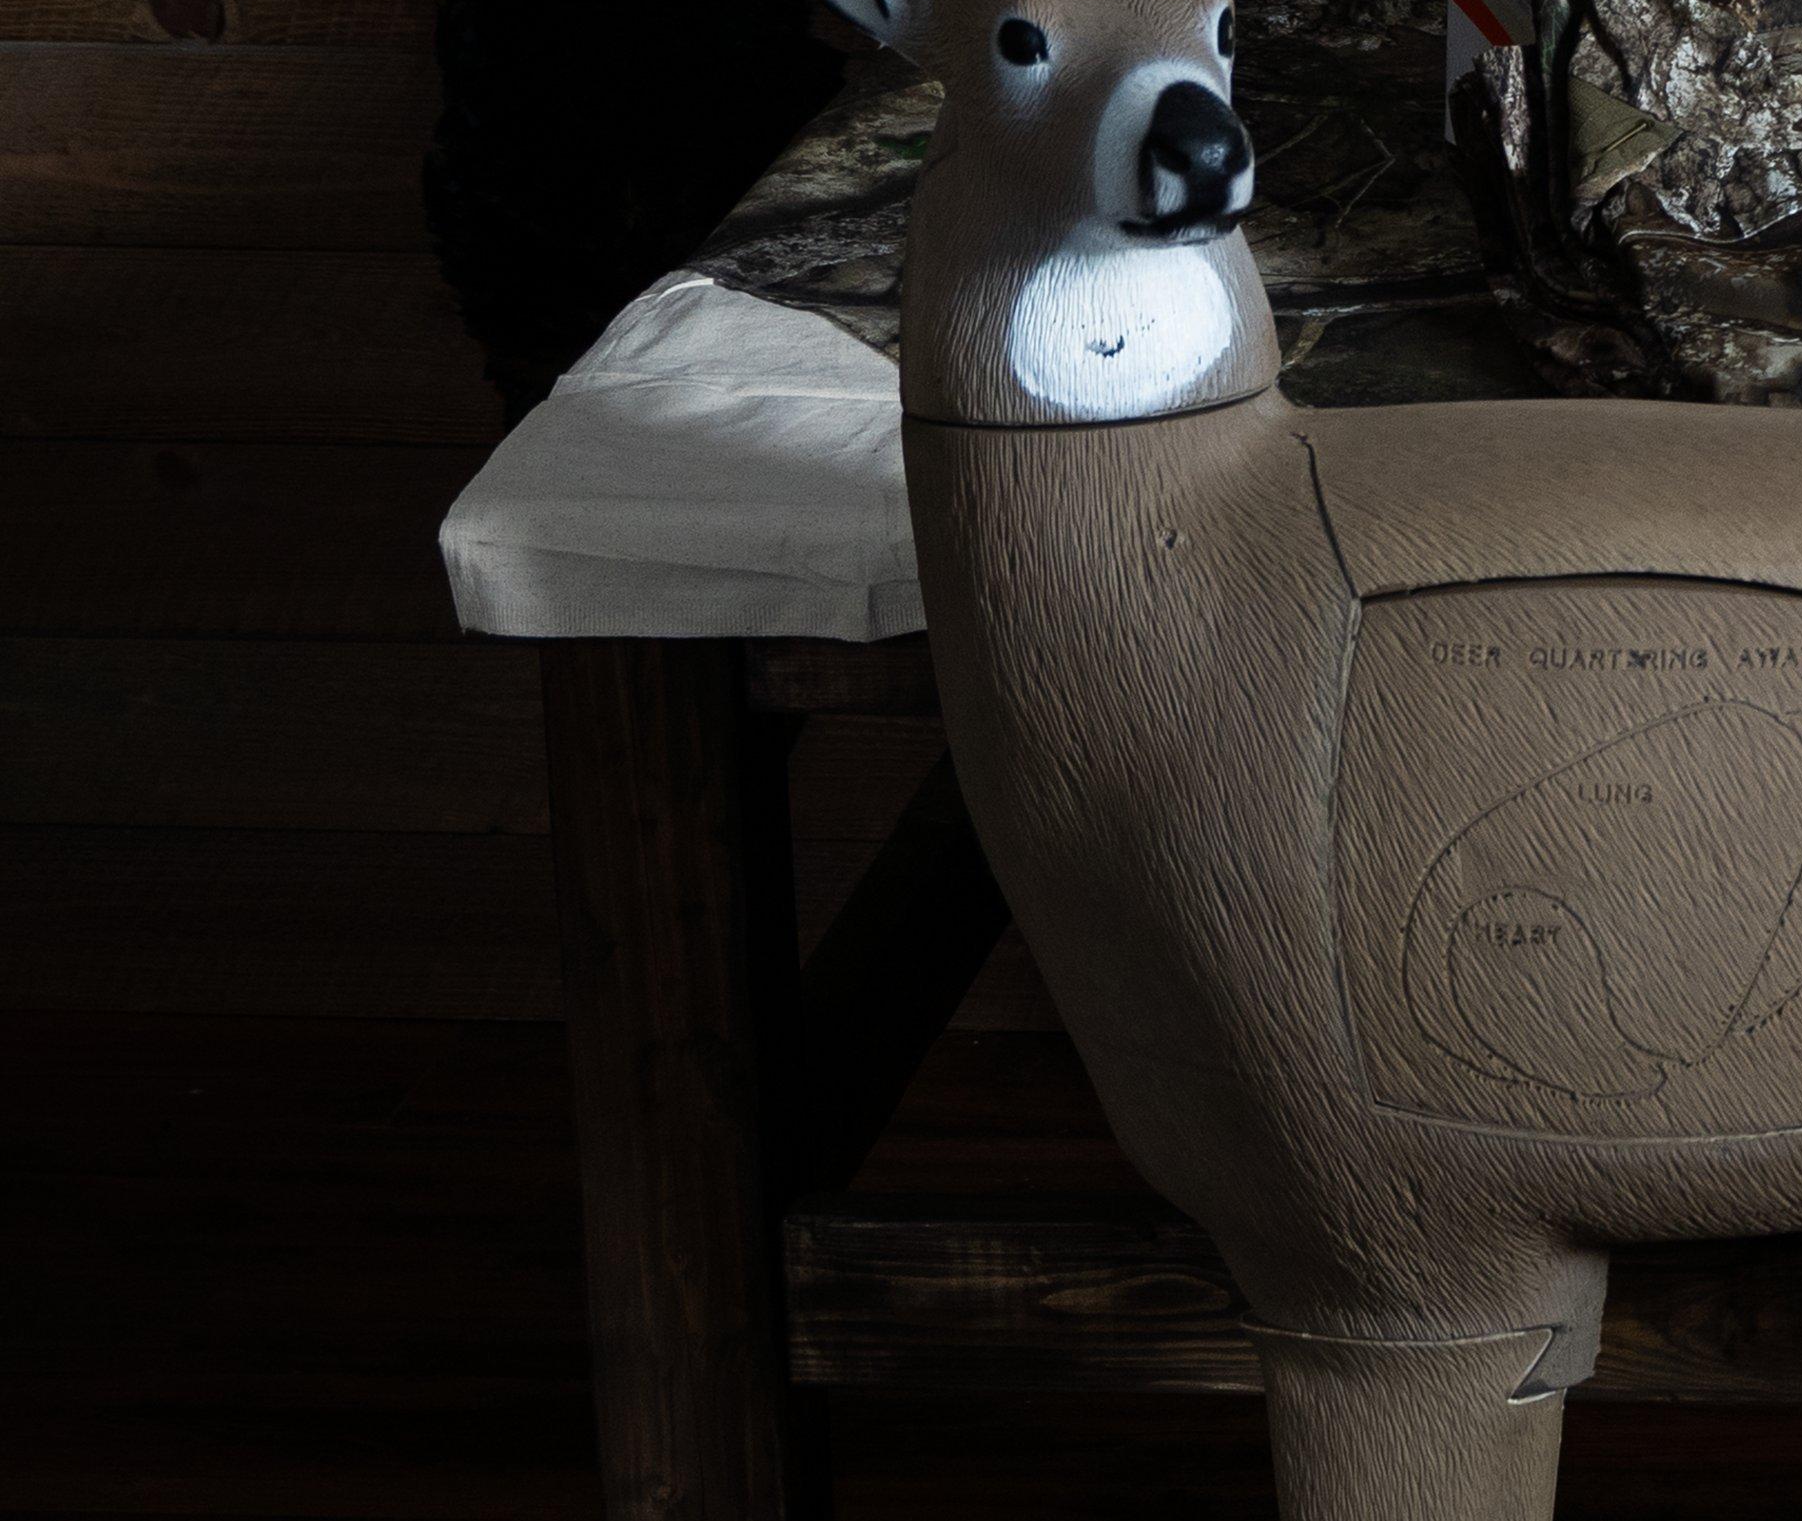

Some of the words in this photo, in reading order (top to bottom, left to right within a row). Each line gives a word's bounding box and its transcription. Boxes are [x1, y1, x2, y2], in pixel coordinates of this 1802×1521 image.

[1431, 641, 1501, 667] DEER
[1577, 783, 1654, 805] LUNG
[1474, 923, 1562, 946] HEART
